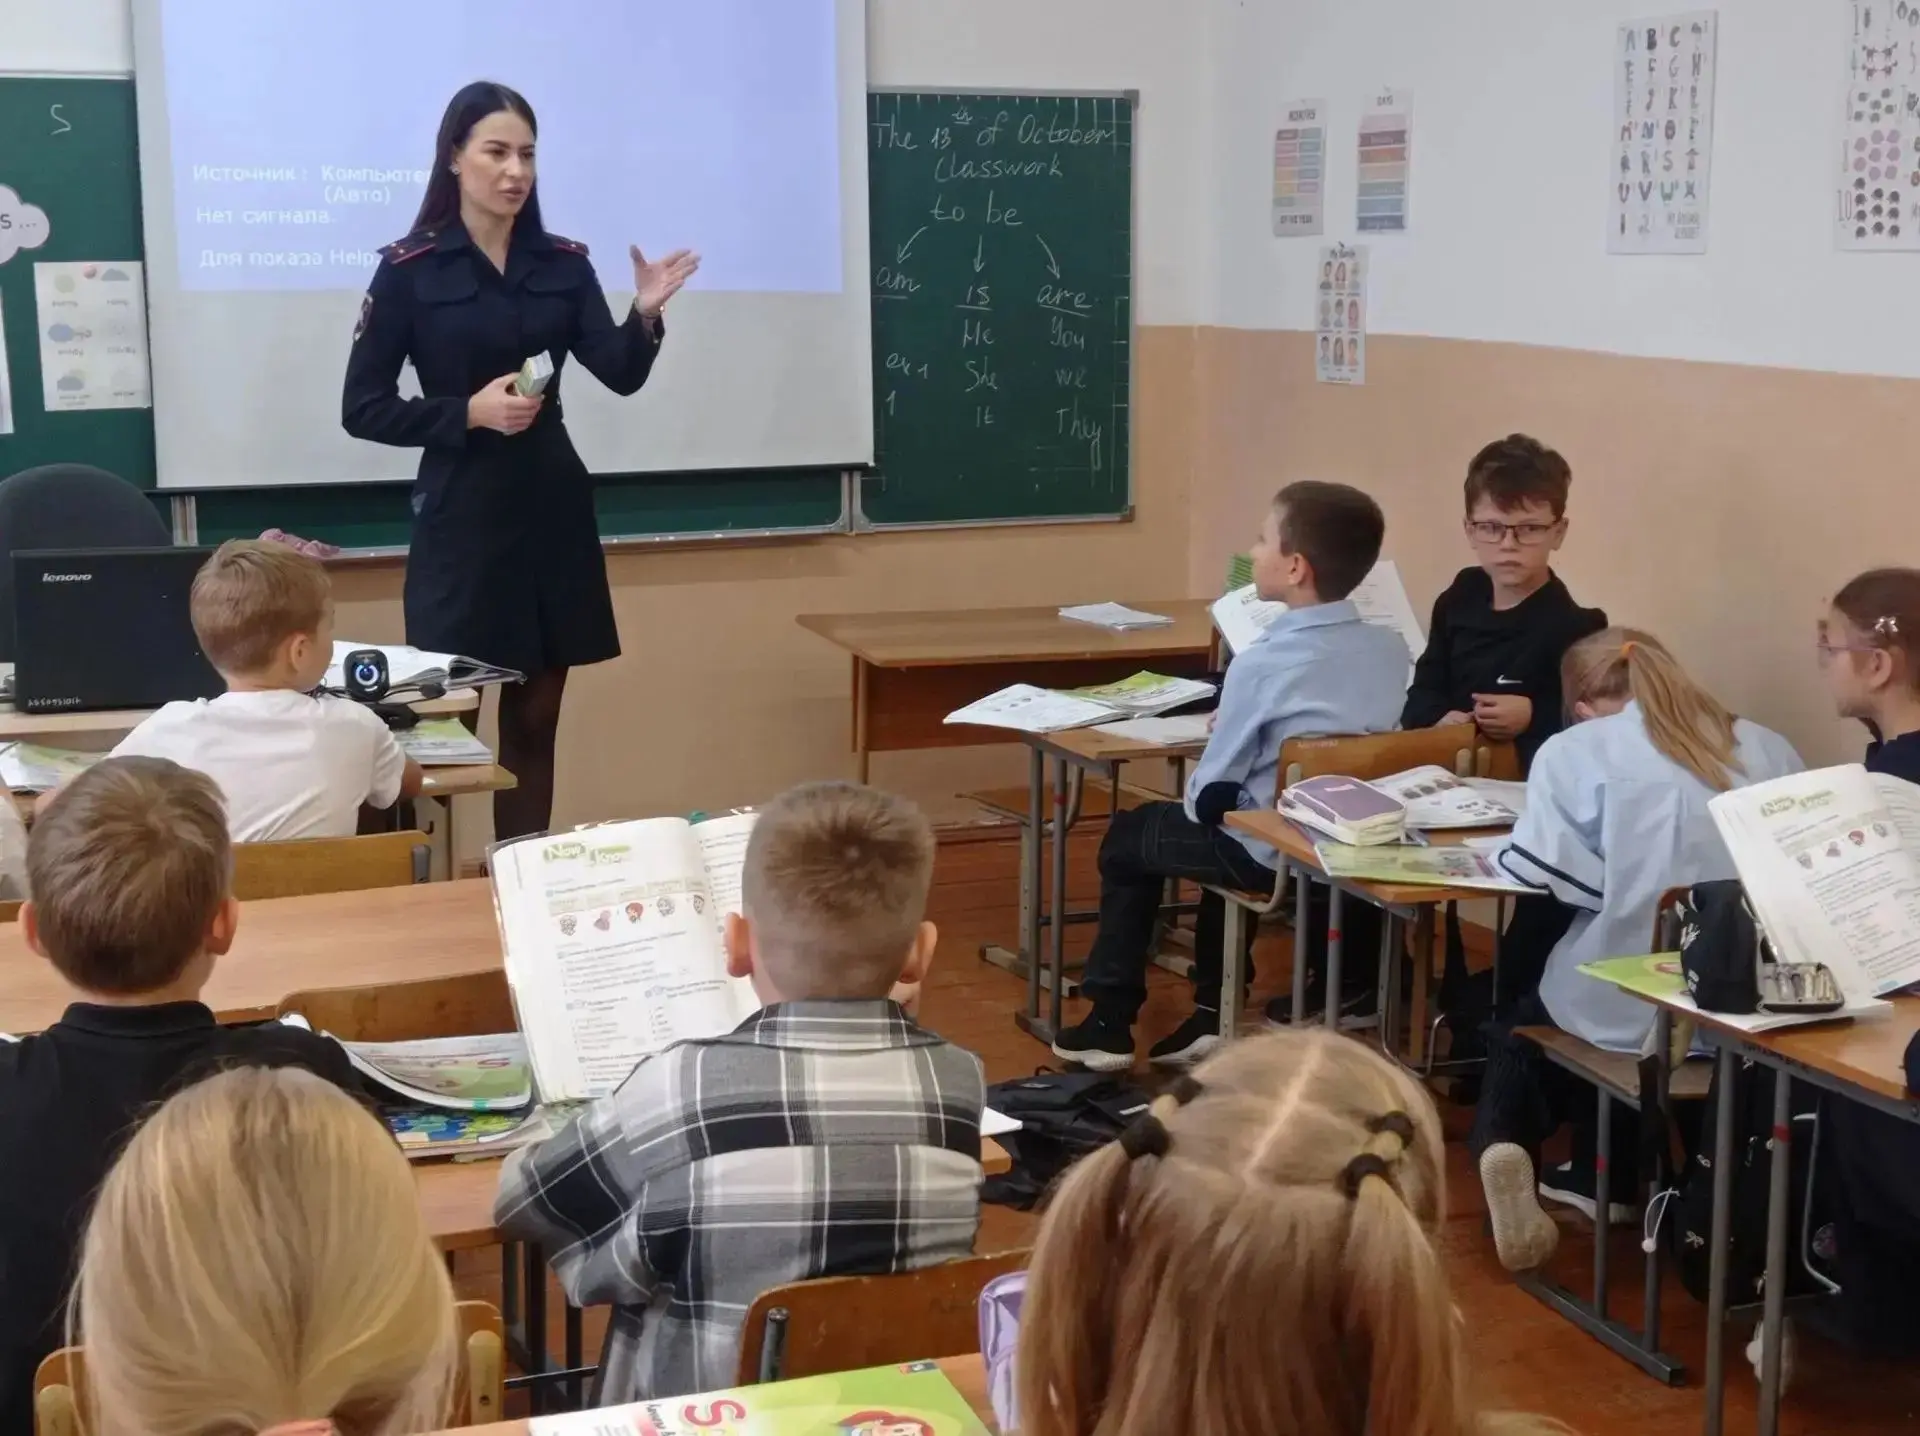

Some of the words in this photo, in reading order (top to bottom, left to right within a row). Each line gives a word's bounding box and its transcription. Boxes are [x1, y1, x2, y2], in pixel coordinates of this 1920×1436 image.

[870, 113, 918, 150] The
[976, 110, 1007, 147] of
[934, 152, 1064, 183] Classwork
[324, 186, 391, 206] (Авто)
[930, 193, 966, 222] to
[986, 190, 1024, 226] be
[196, 208, 233, 225] Нет
[200, 249, 243, 269] Для
[249, 250, 323, 267] показа
[875, 266, 921, 293] am
[1037, 284, 1093, 309] are
[964, 355, 999, 393] She
[42, 572, 93, 583] lenovo
